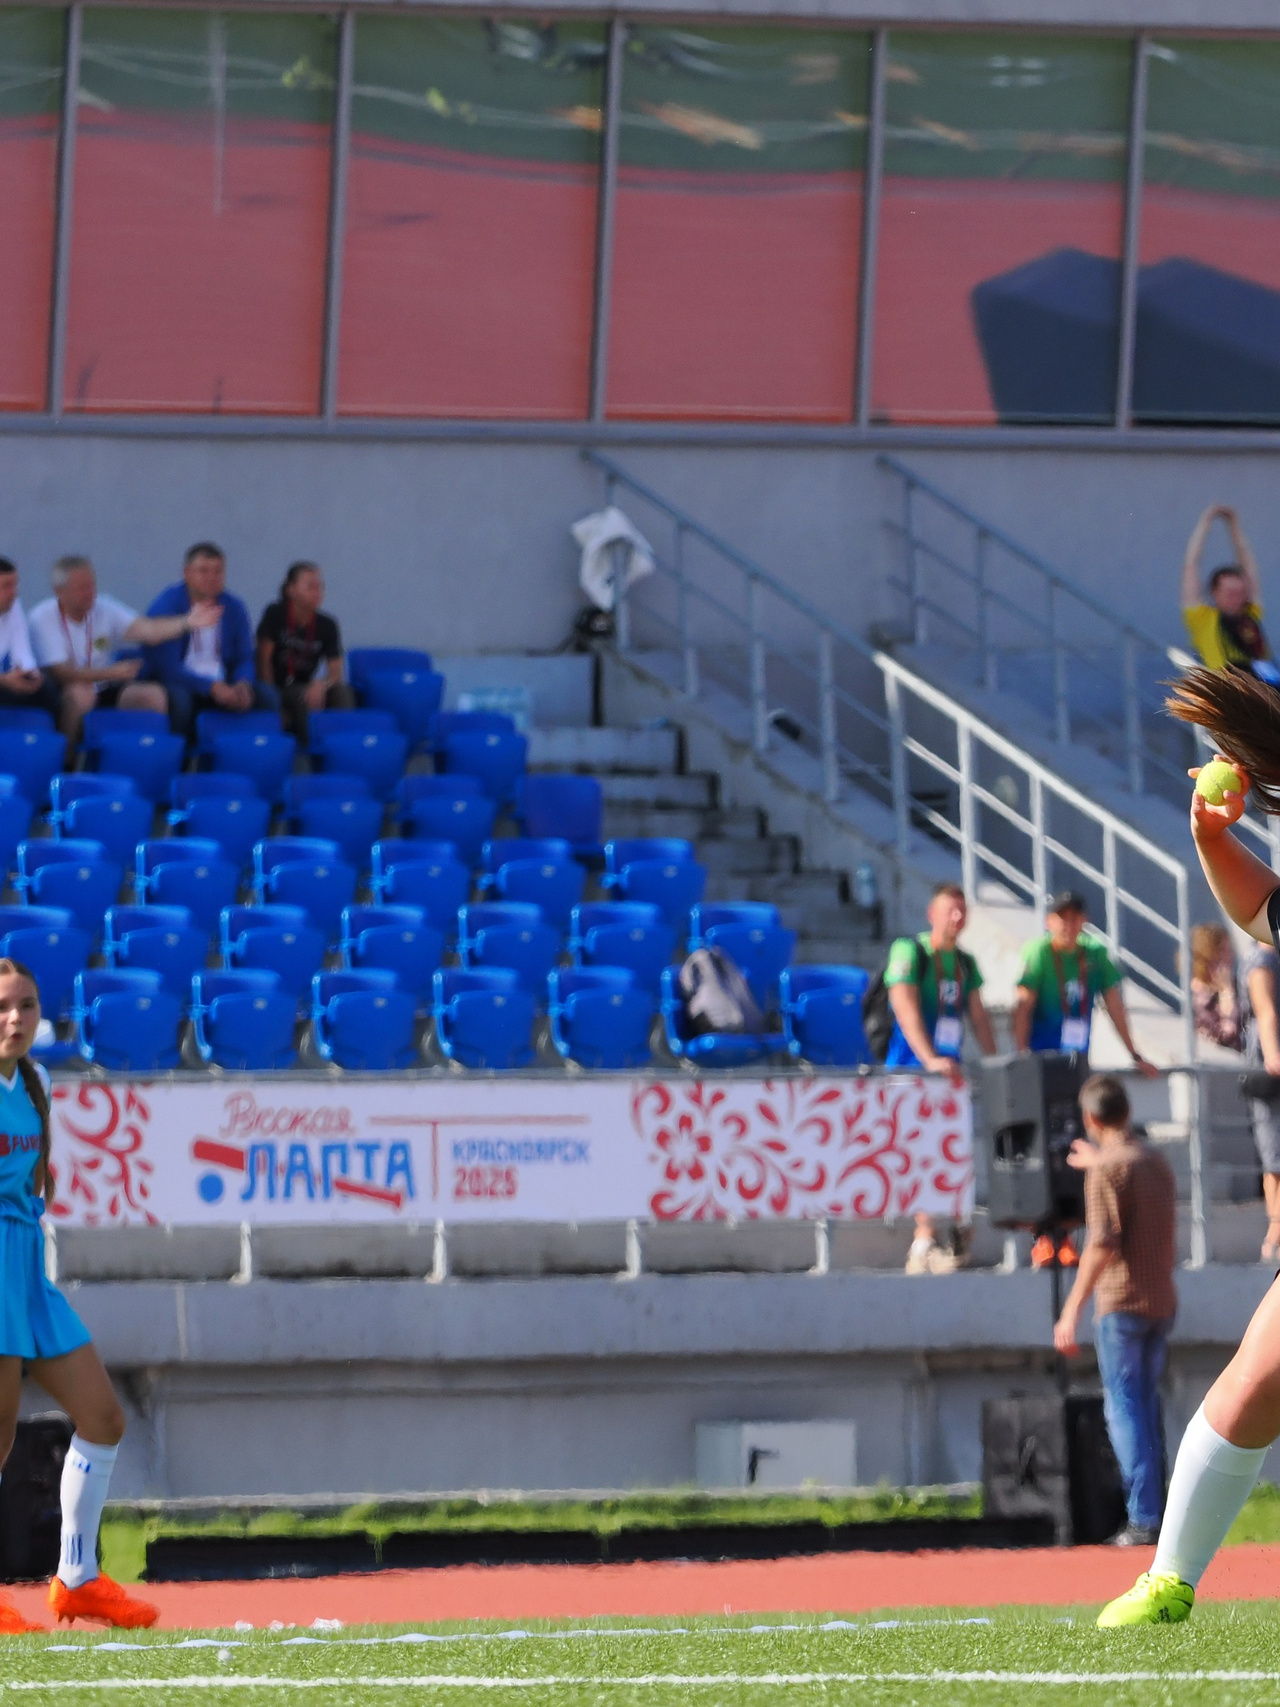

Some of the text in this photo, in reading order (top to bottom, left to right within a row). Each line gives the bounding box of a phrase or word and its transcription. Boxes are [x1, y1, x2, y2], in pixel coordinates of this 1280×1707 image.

[219, 1090, 356, 1138] Русская
[241, 1142, 415, 1200] ЛАПТА
[452, 1140, 590, 1164] КРАСНОЯРСК
[454, 1166, 517, 1198] 2025
